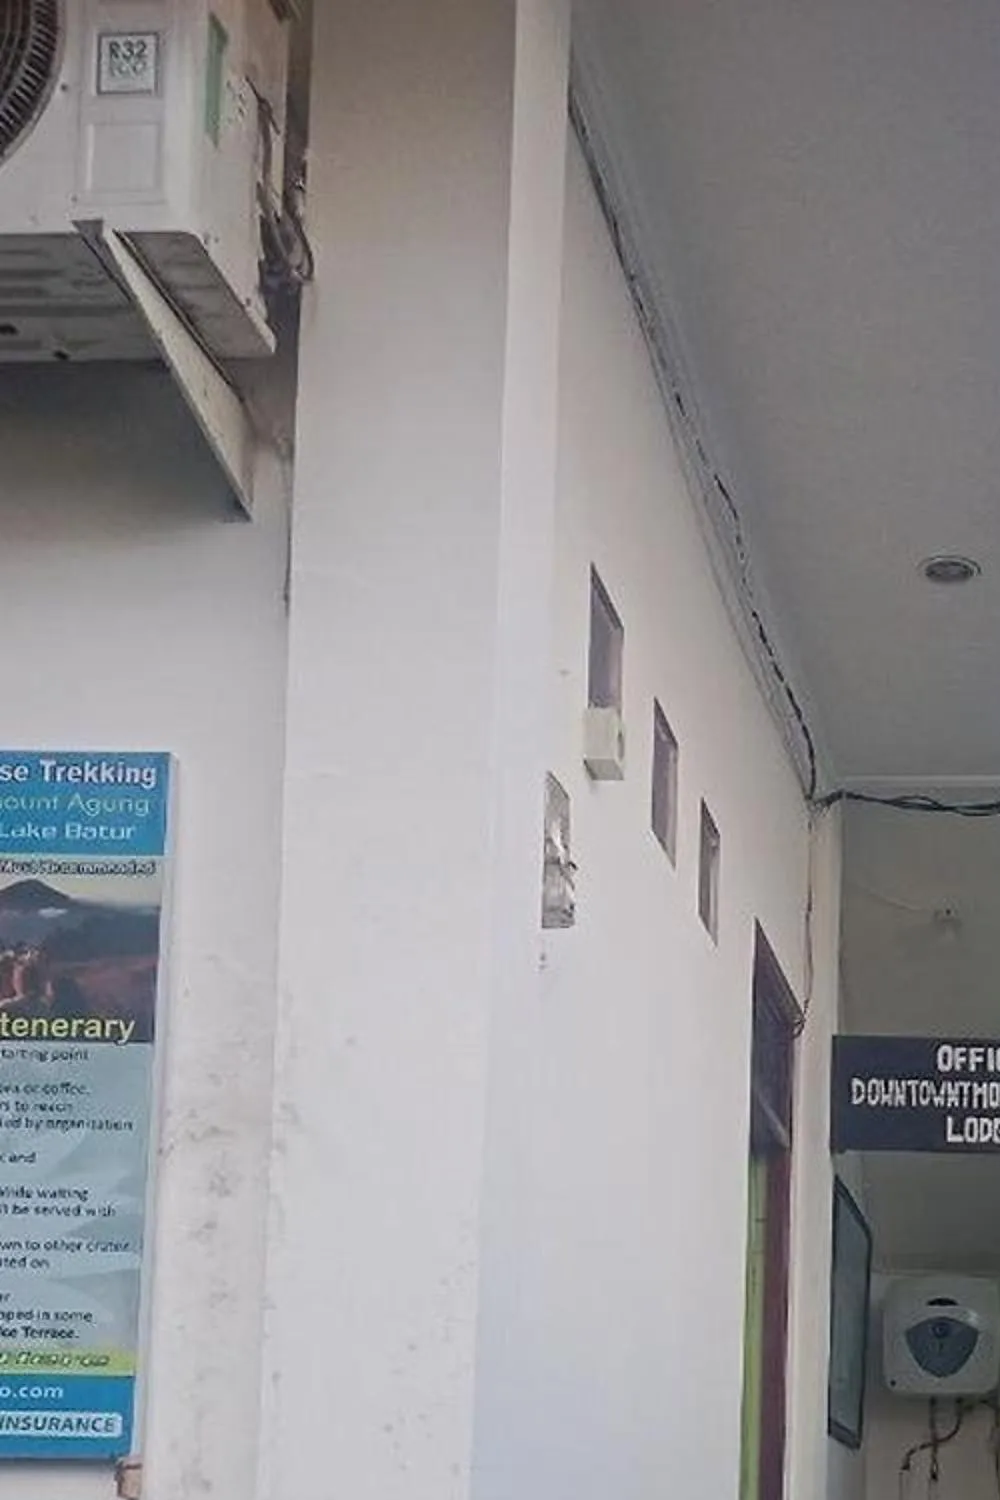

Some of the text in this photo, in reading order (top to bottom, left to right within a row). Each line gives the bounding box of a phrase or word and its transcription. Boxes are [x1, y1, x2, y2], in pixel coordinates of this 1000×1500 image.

[40, 758, 157, 789] Trekking
[0, 792, 149, 817] ount Agung
[65, 822, 136, 840] Batur
[0, 1011, 136, 1045] tenerary
[12, 1203, 30, 1215] be
[33, 1204, 81, 1217] served
[25, 1240, 41, 1251] to
[43, 1239, 83, 1253] other
[30, 1258, 50, 1269] on
[37, 1310, 50, 1320] in
